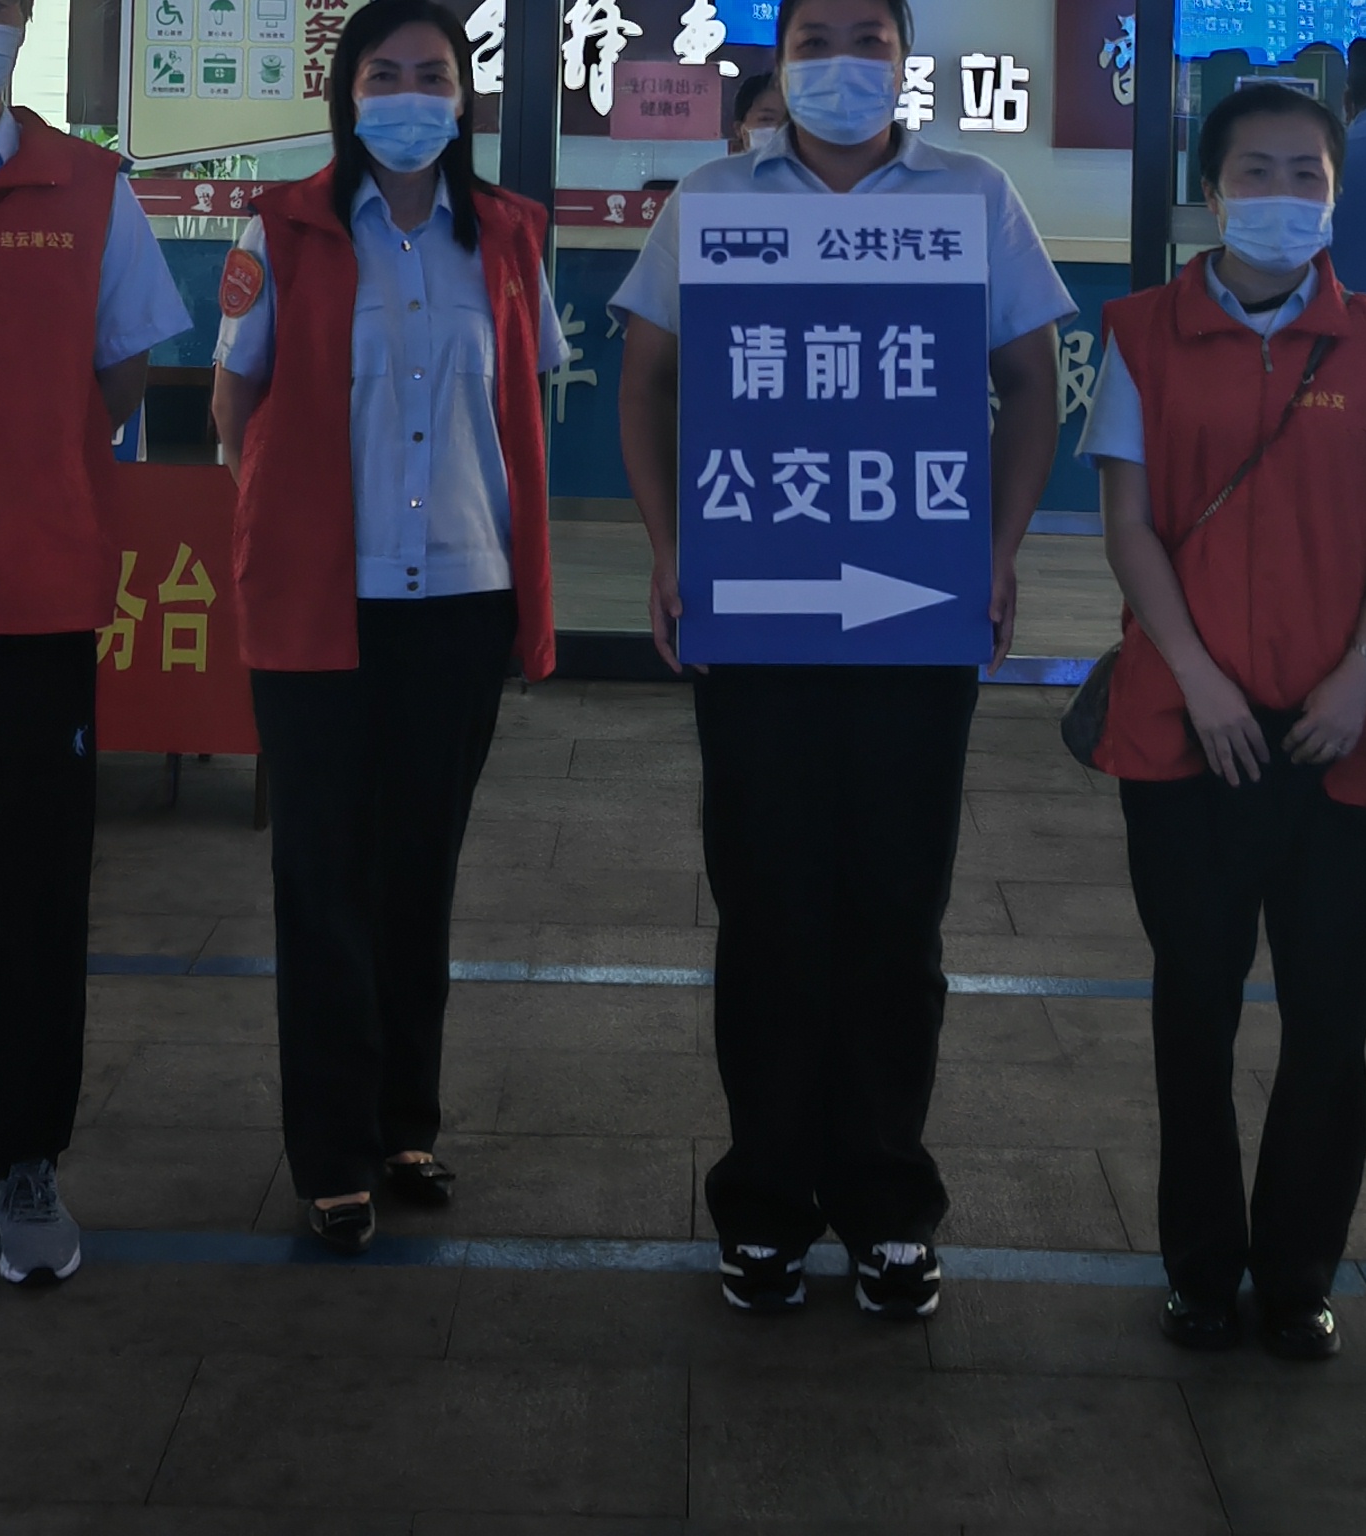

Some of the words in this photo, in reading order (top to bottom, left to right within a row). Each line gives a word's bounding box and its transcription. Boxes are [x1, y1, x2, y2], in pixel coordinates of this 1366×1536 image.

[0, 231, 74, 250] 连云港公交
[817, 226, 964, 263] 公共汽车
[728, 324, 937, 401] 请前往
[696, 448, 971, 523] 公交B区
